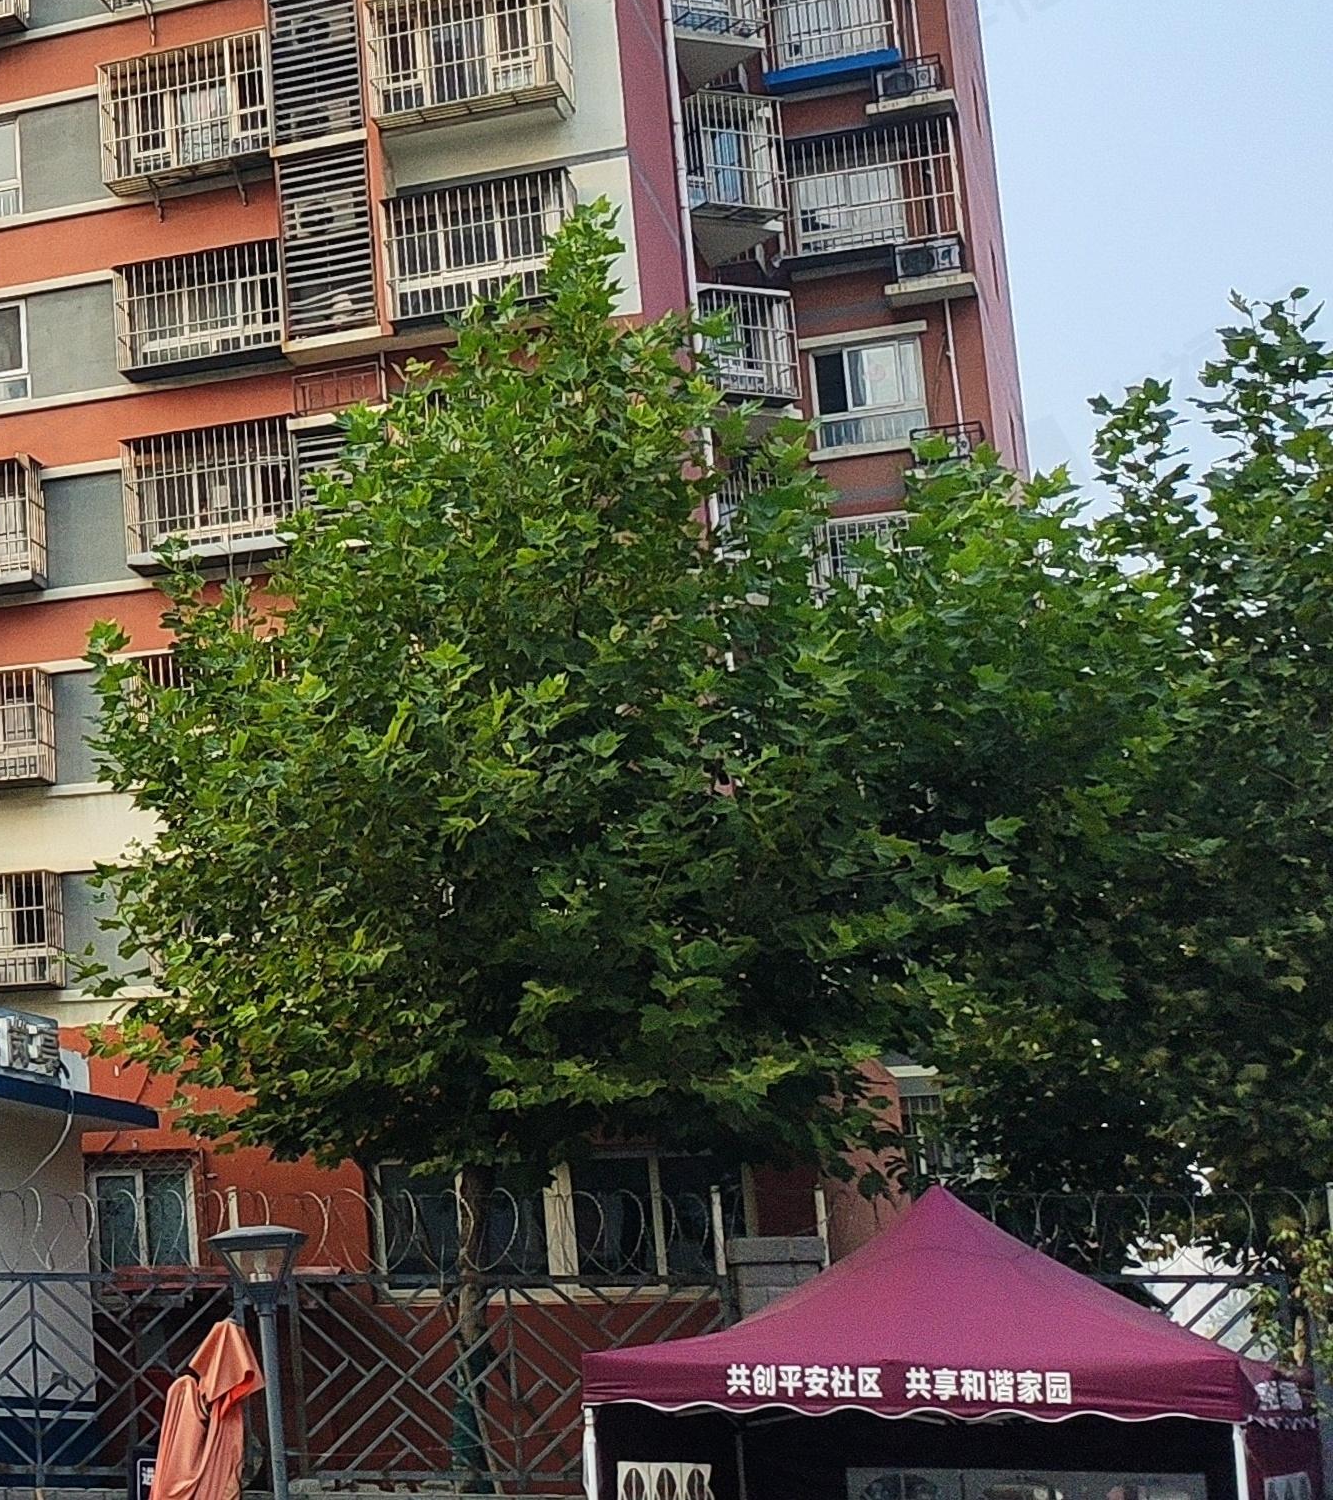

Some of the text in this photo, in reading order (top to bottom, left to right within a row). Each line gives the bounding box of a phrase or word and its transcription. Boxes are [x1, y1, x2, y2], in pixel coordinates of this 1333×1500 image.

[726, 1363, 1073, 1405] 共创平安社区 共享和谐家园
